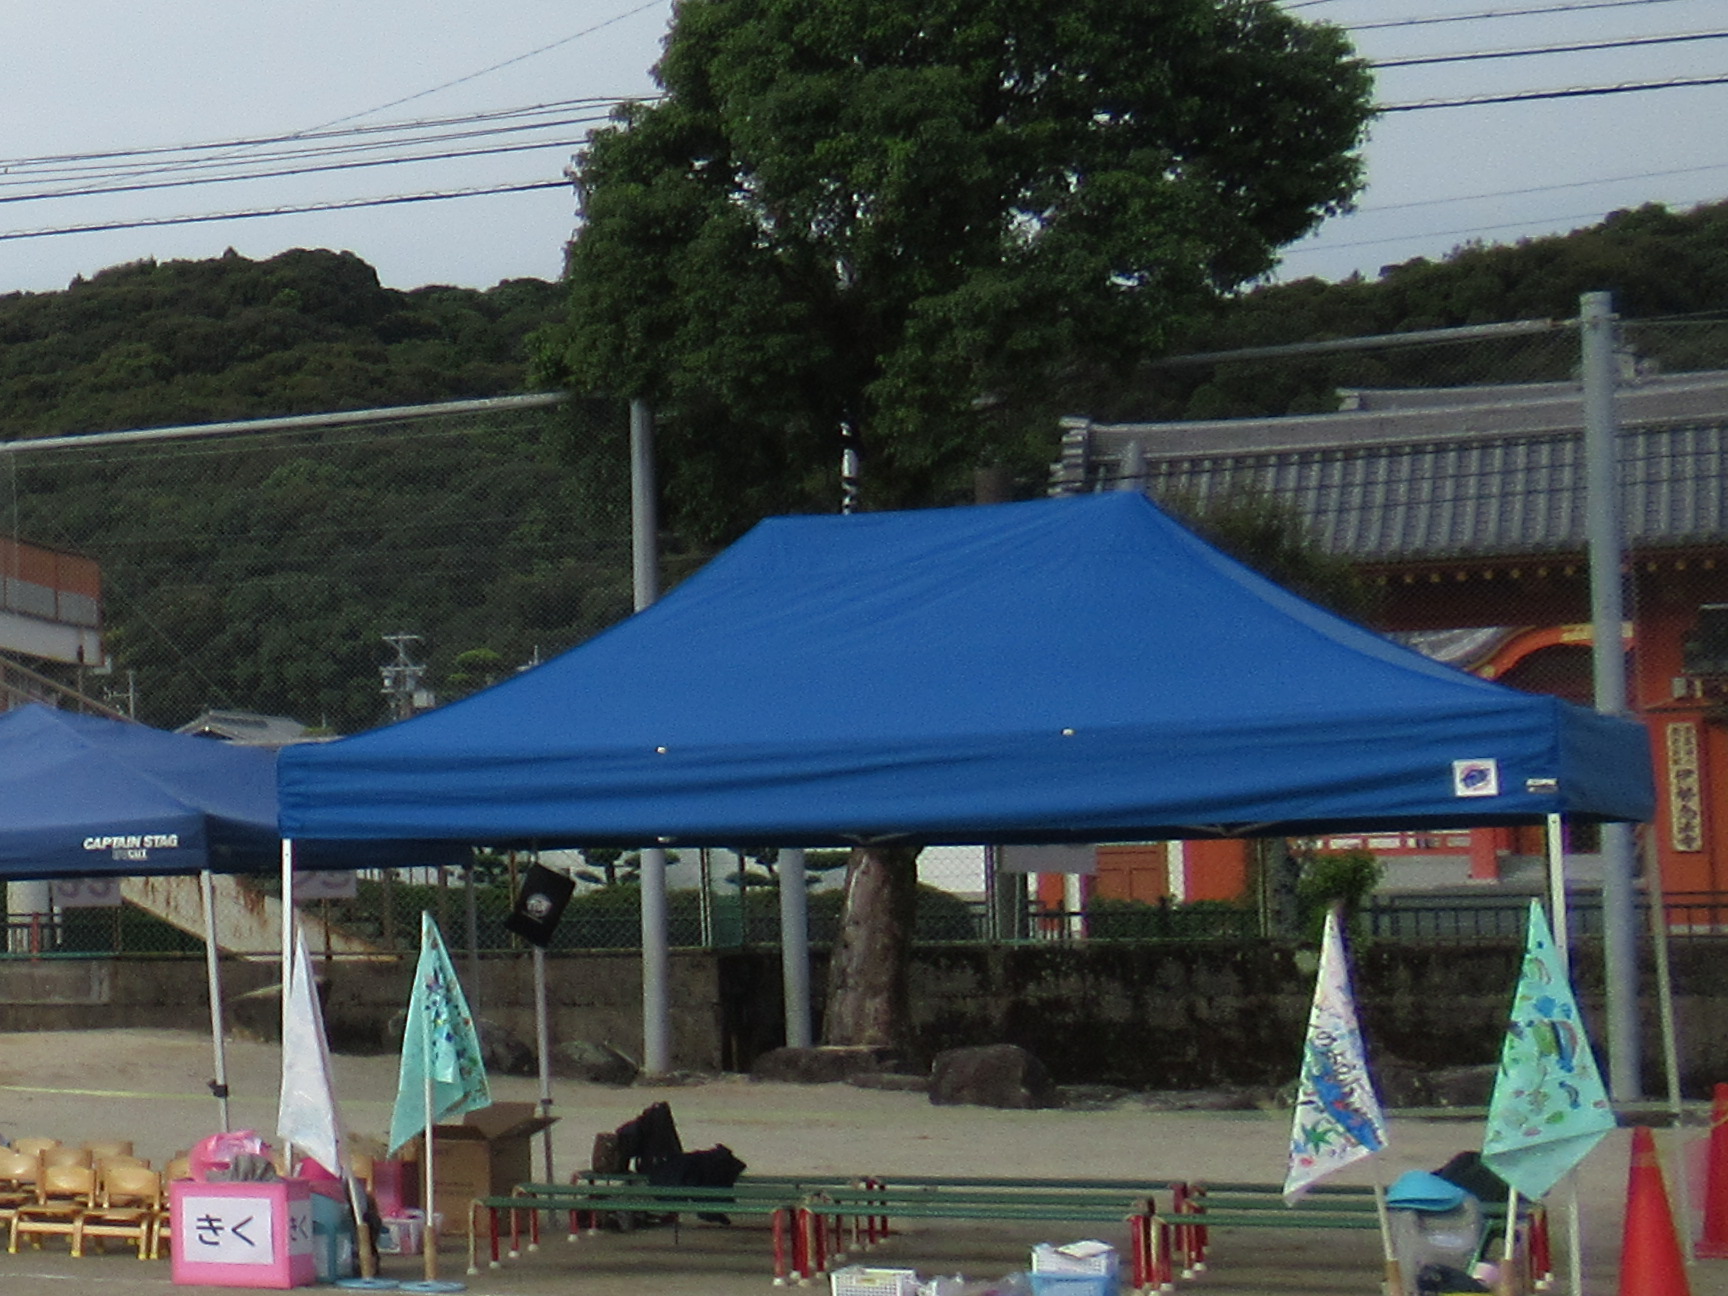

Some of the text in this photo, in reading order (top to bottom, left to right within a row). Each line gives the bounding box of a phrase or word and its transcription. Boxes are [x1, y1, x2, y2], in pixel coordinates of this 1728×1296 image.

[83, 833, 179, 850] CAPTAIN STAG
[196, 1214, 256, 1247] きく
